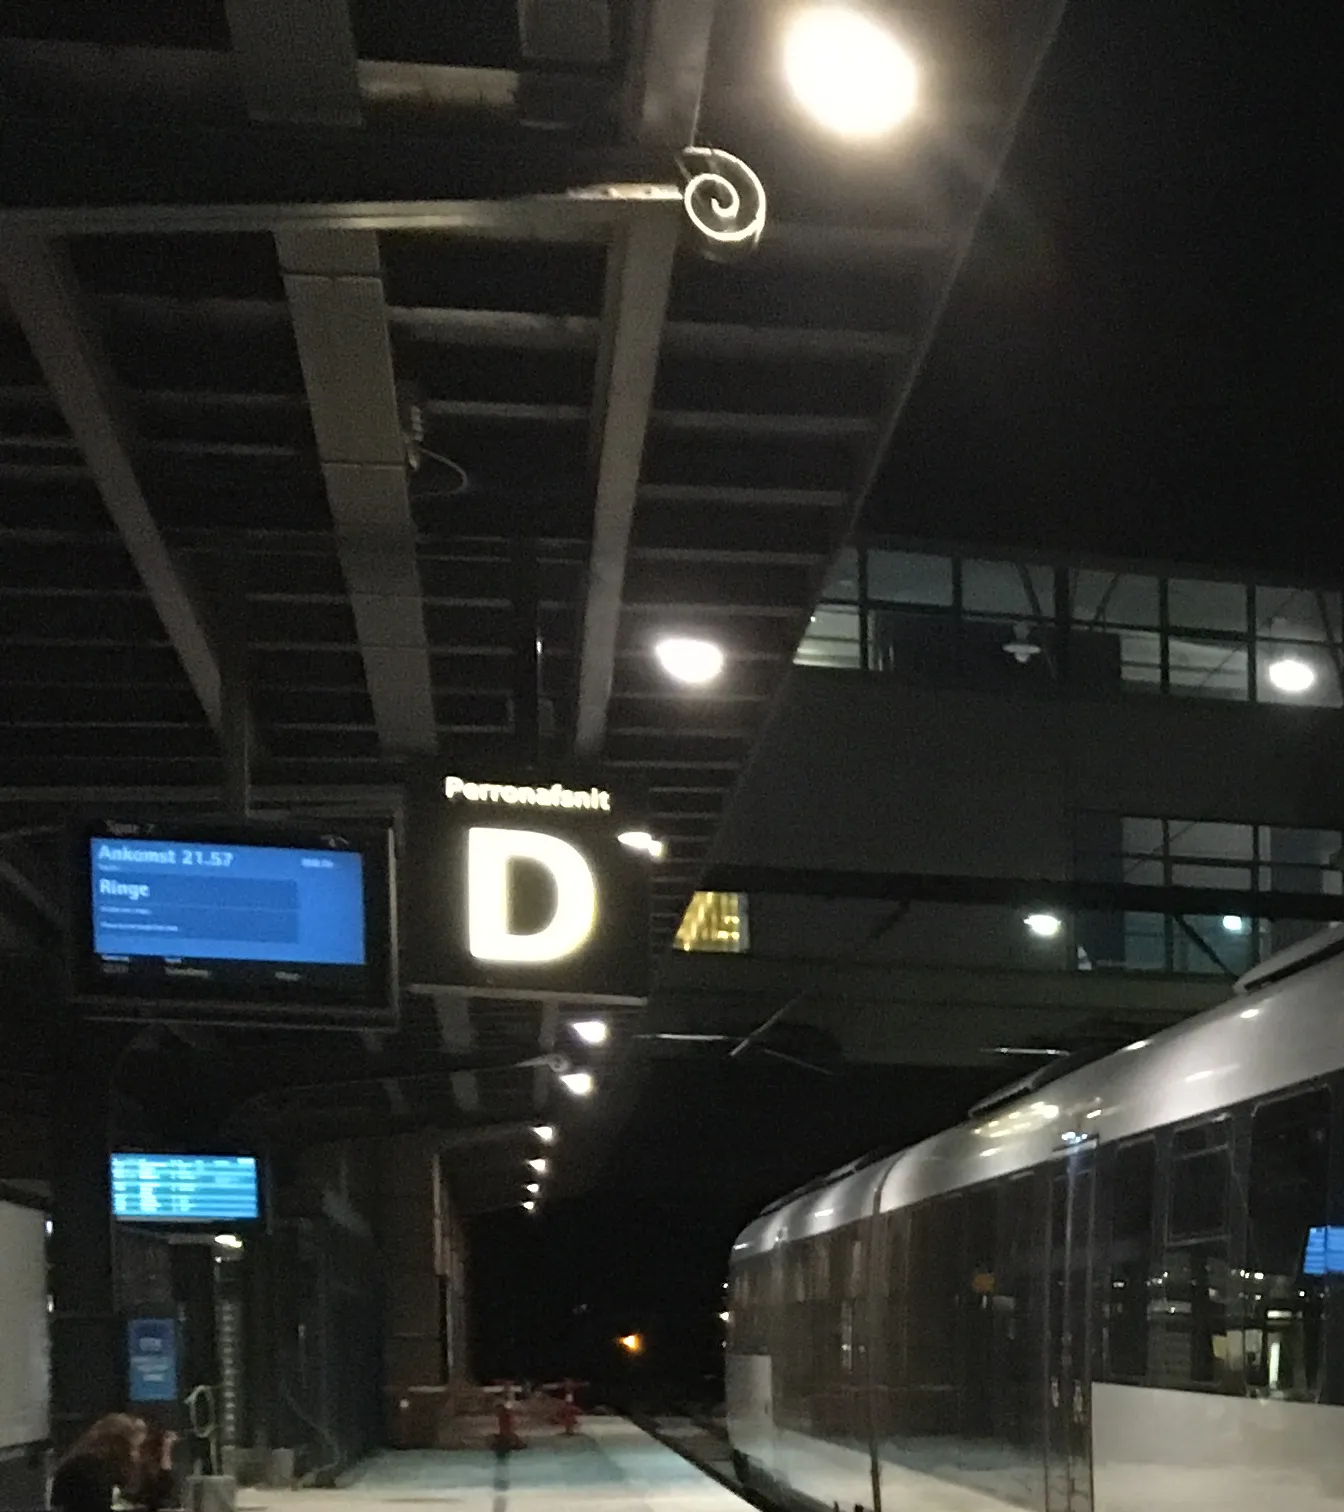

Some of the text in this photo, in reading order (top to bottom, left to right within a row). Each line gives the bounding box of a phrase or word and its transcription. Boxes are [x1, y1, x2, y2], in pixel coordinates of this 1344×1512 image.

[100, 845, 233, 867] Ankomst 21.57
[100, 878, 149, 900] Ringe
[468, 827, 595, 961] D
